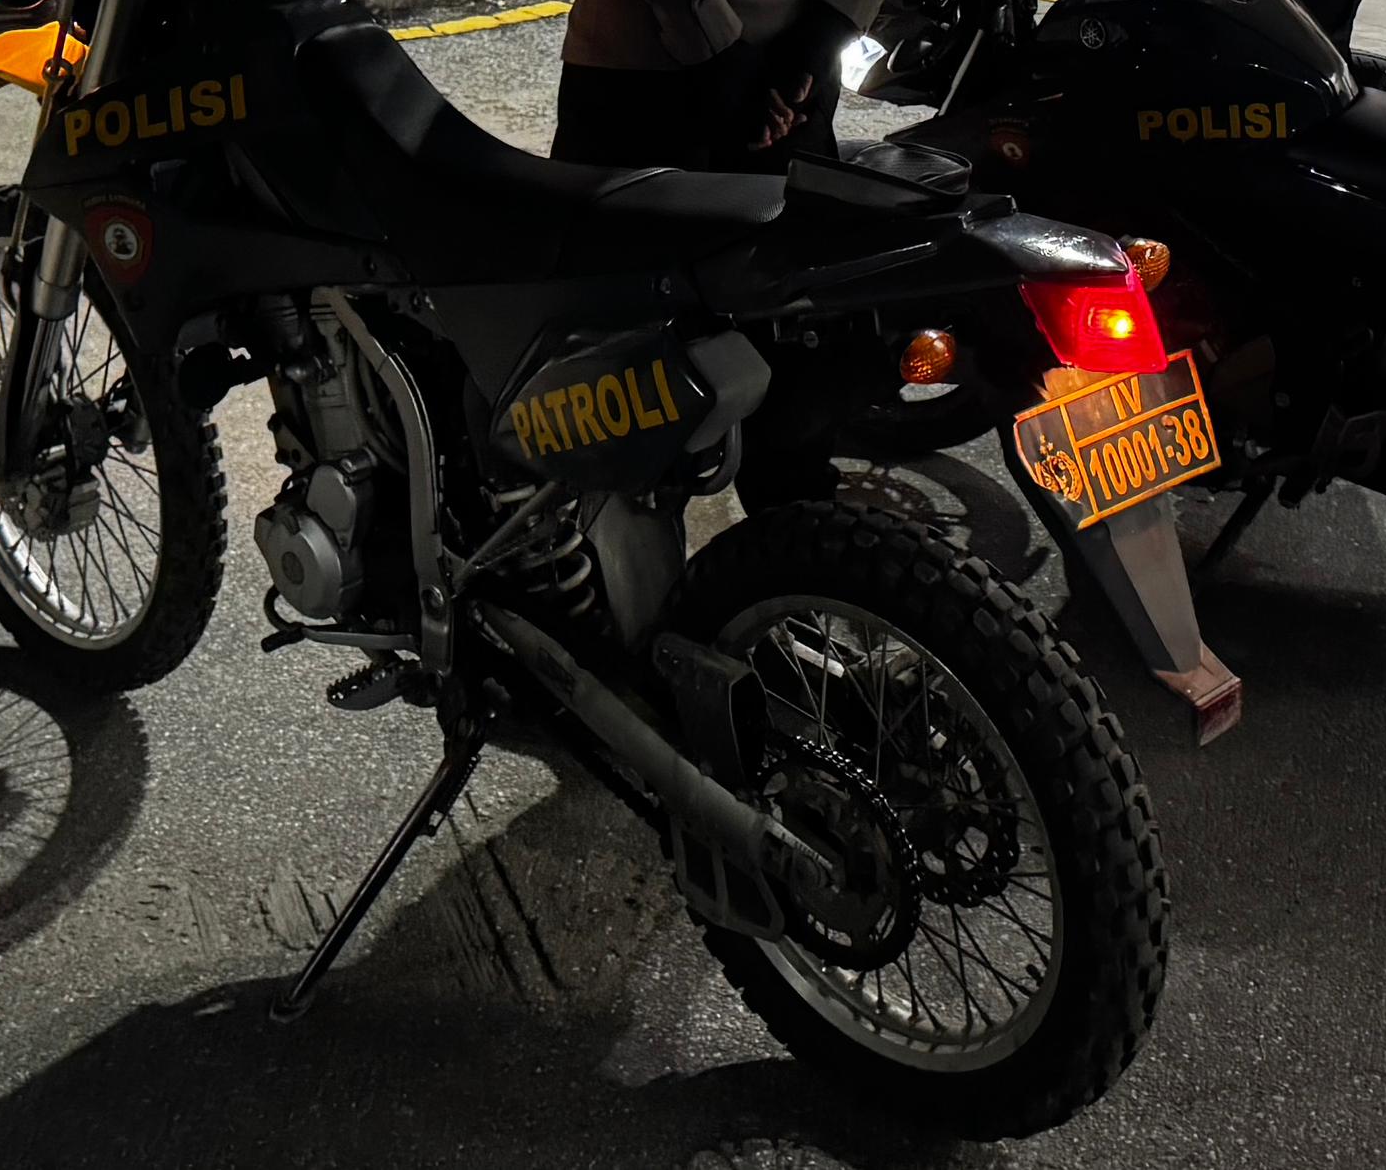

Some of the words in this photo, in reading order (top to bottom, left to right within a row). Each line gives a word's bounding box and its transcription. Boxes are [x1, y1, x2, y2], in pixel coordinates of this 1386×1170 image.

[64, 73, 248, 157] POLISI
[1137, 102, 1288, 141] POLISI
[510, 358, 681, 461] PATROLI
[1108, 375, 1143, 420] IV
